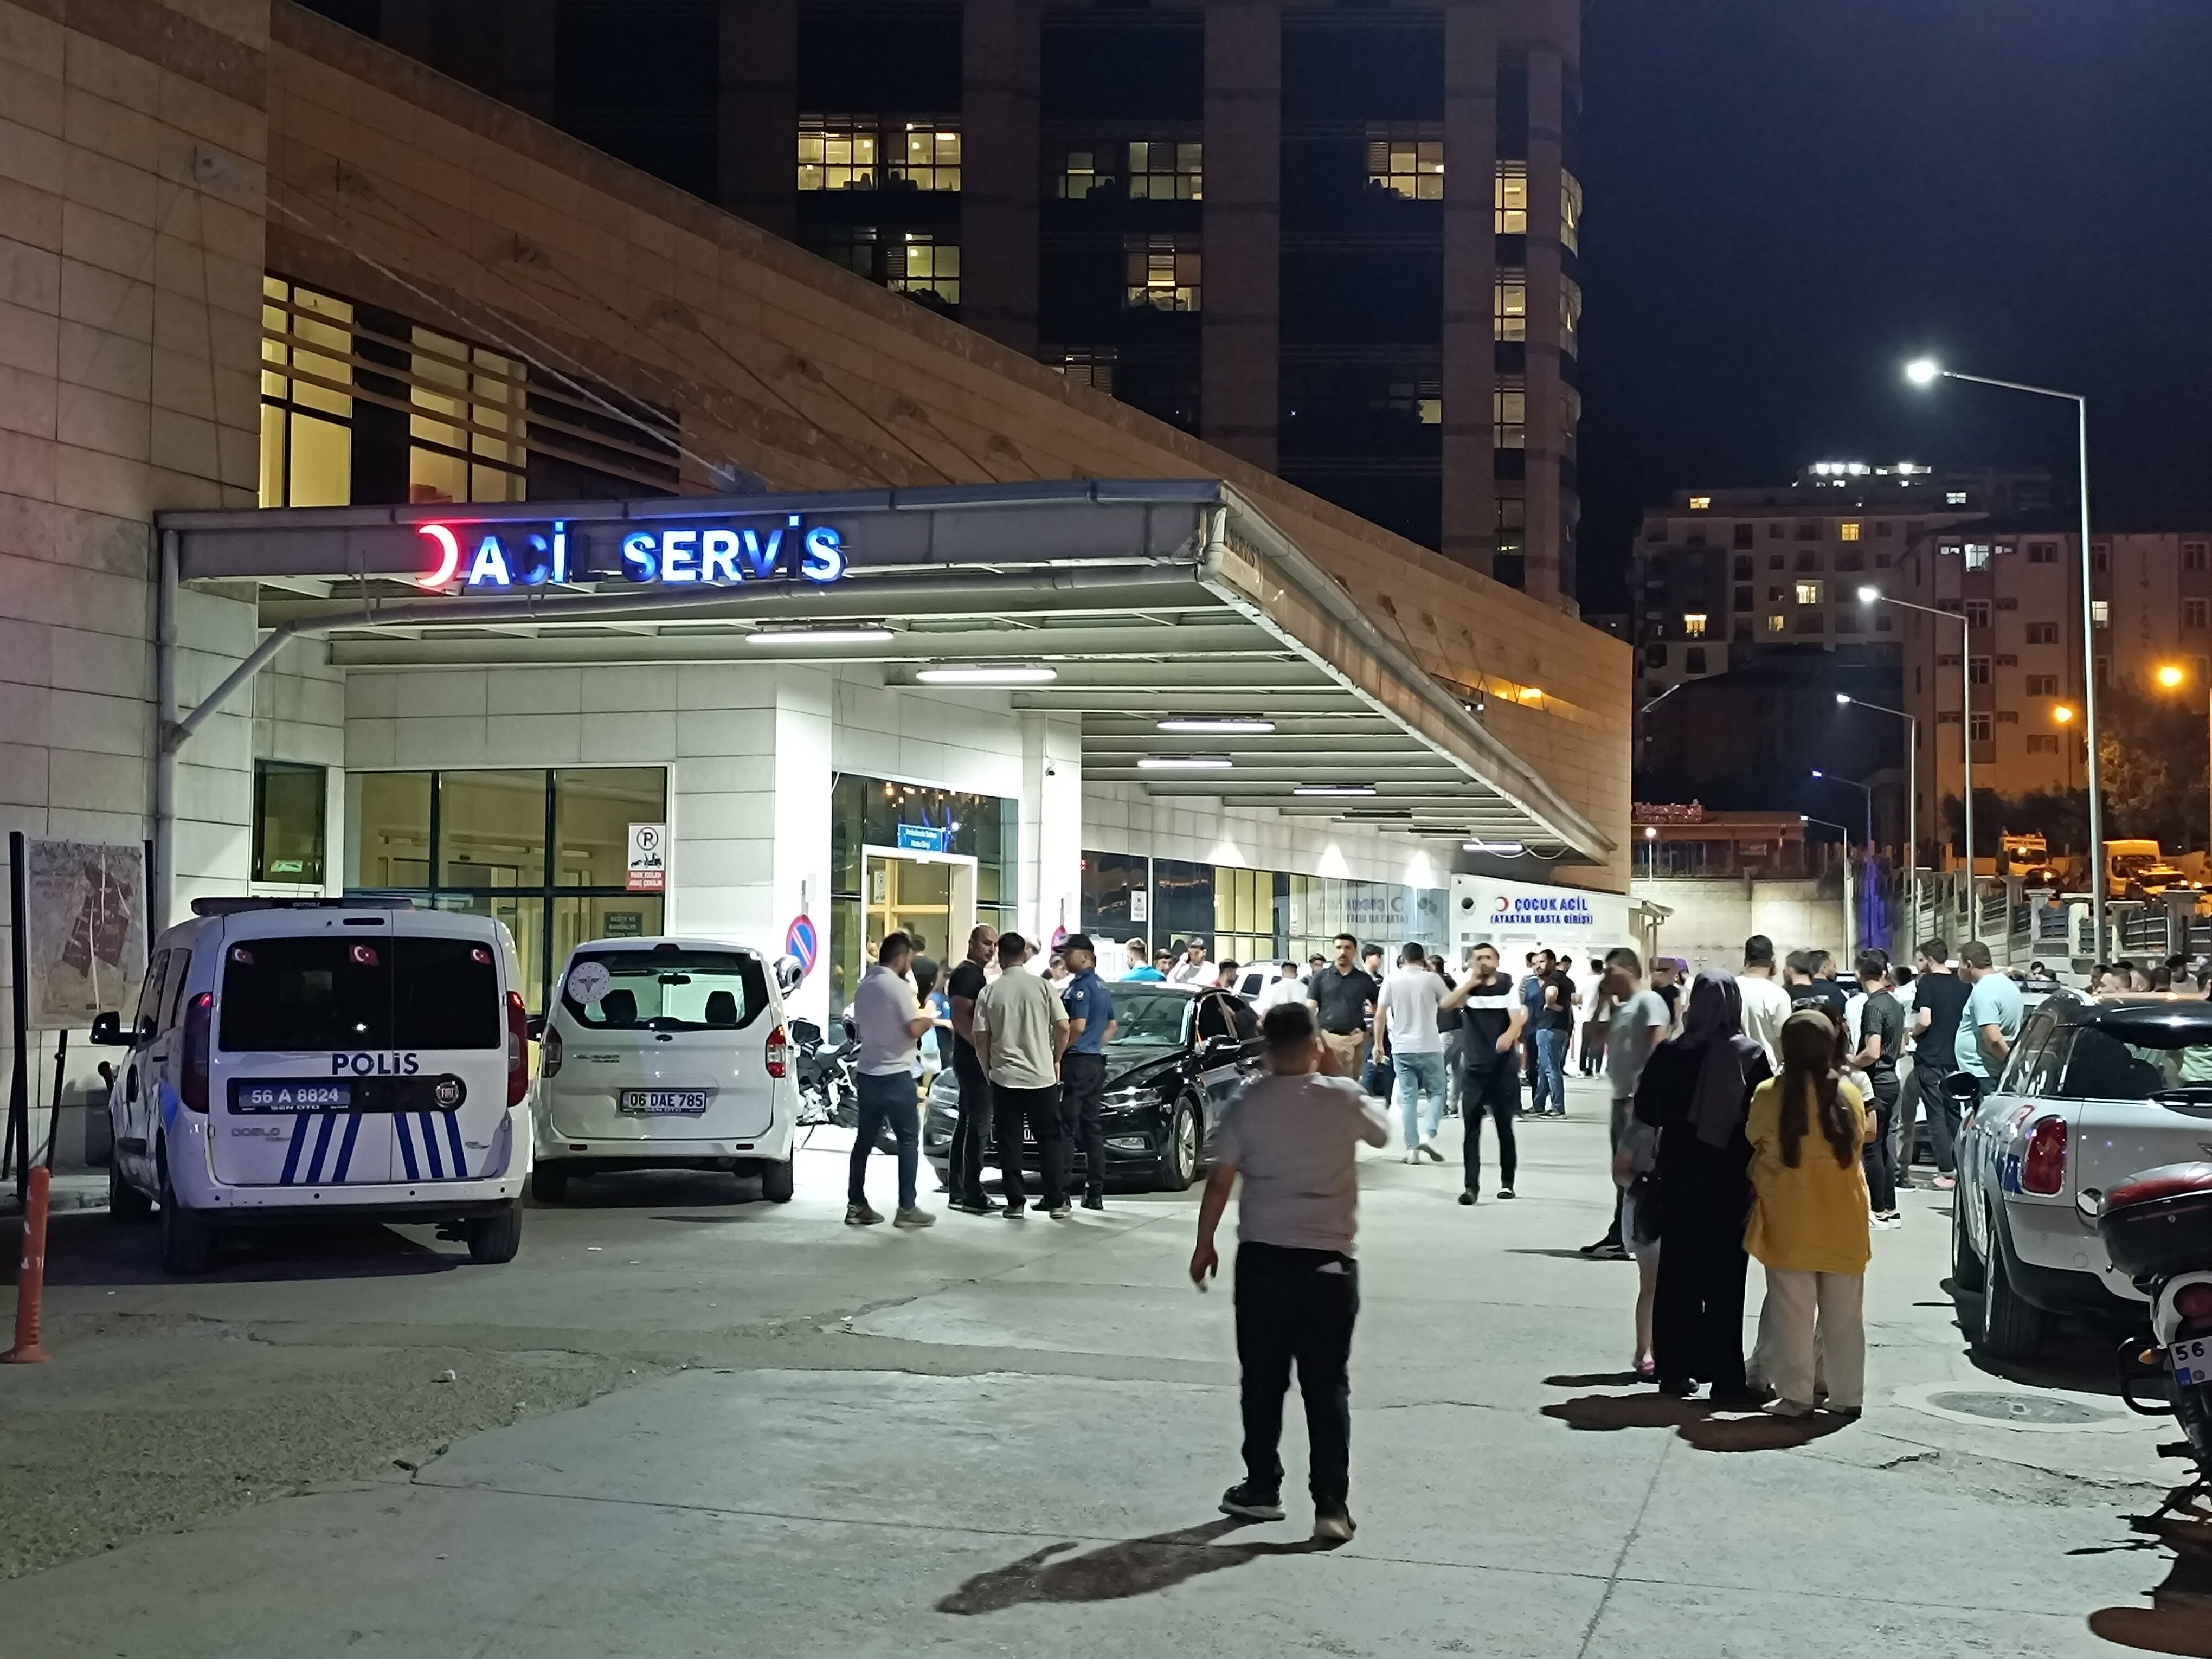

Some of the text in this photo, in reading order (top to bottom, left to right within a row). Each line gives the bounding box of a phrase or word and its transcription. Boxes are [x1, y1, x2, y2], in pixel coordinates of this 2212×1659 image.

[468, 514, 844, 586] ACİL SERVİS
[1515, 896, 1588, 912] ÇOCUK ACİL
[1491, 915, 1532, 924] (AYAKTAN
[1535, 915, 1561, 923] HASTA
[252, 1088, 339, 1104] 56 A 8824
[630, 1093, 703, 1107] 06 DAE 785
[2175, 1341, 2205, 1361] 56
